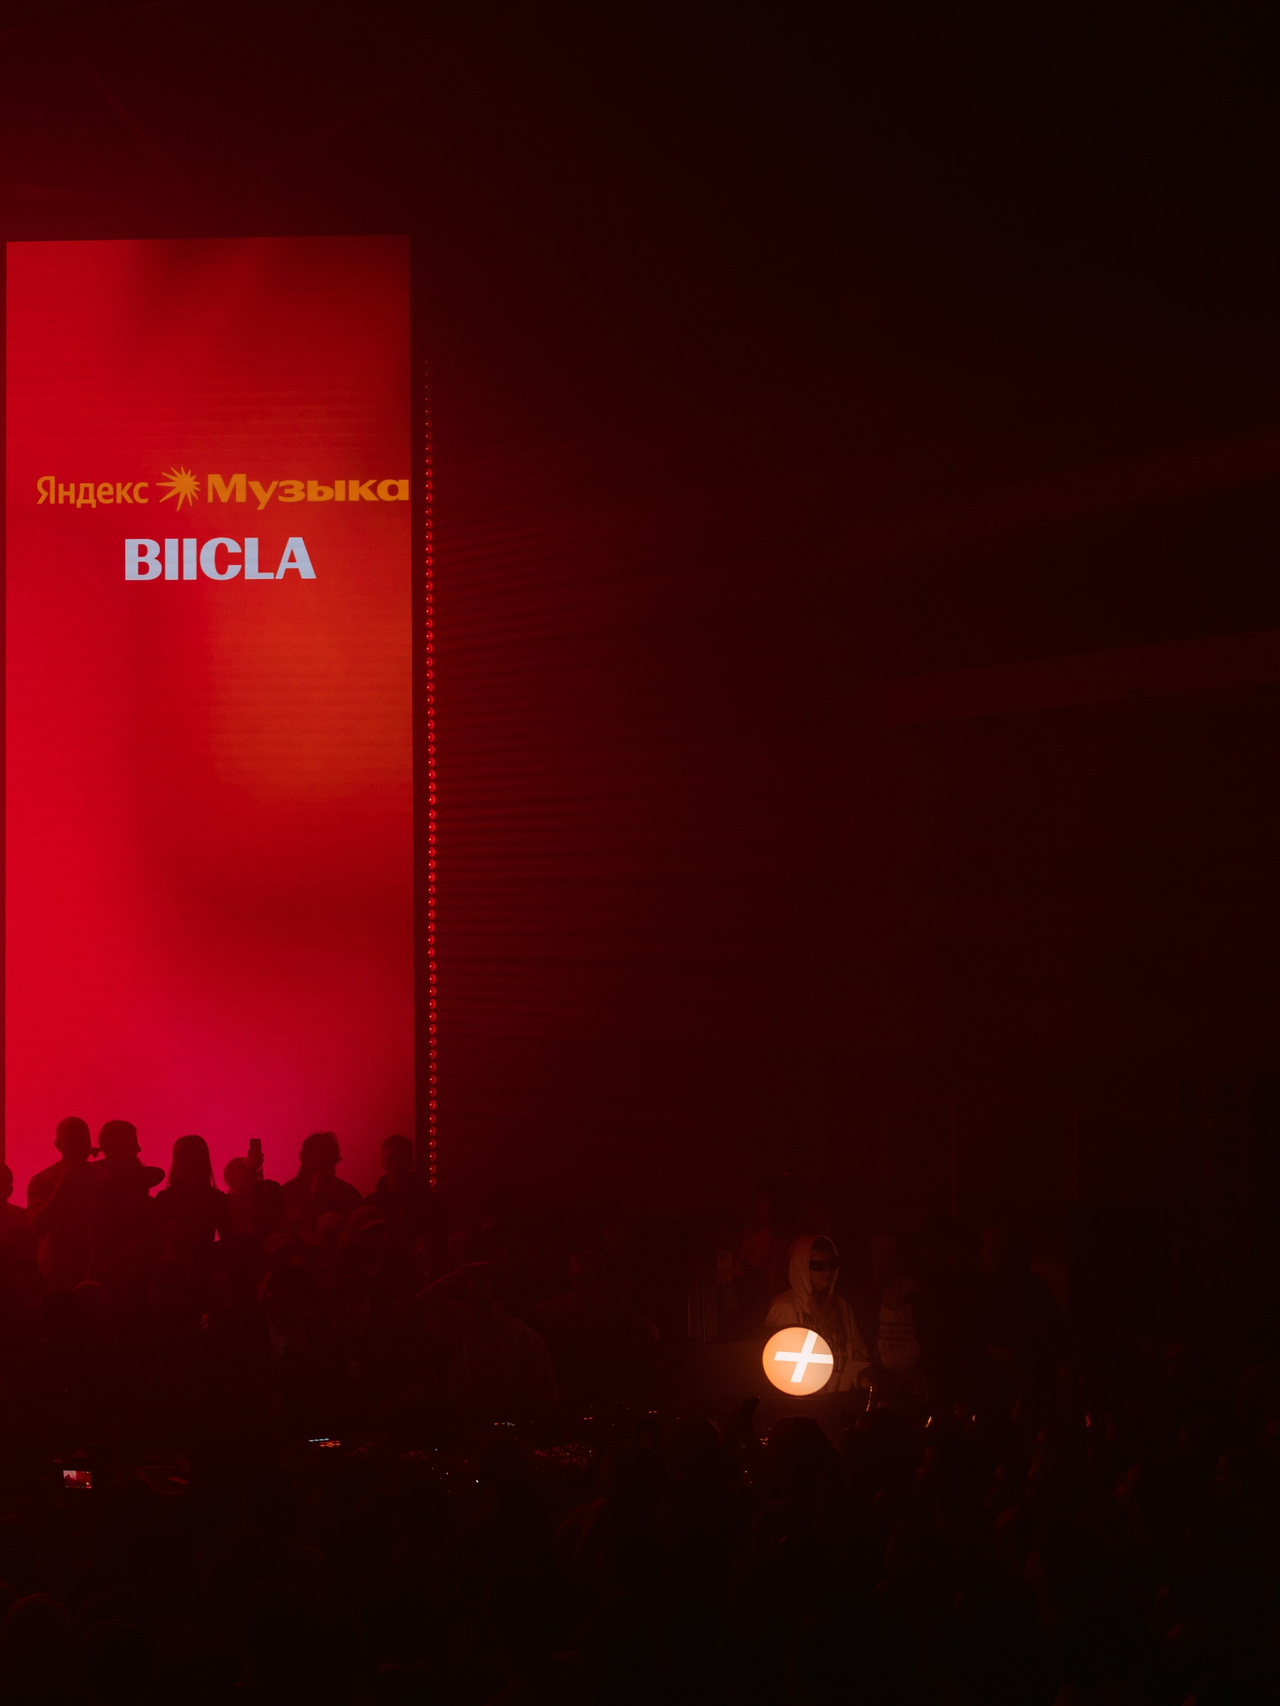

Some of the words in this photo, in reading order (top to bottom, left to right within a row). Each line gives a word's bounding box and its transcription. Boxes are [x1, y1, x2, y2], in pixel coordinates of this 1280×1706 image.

[37, 476, 148, 508] Яндекс
[208, 474, 408, 510] Музыка
[125, 537, 316, 580] BIICLA
